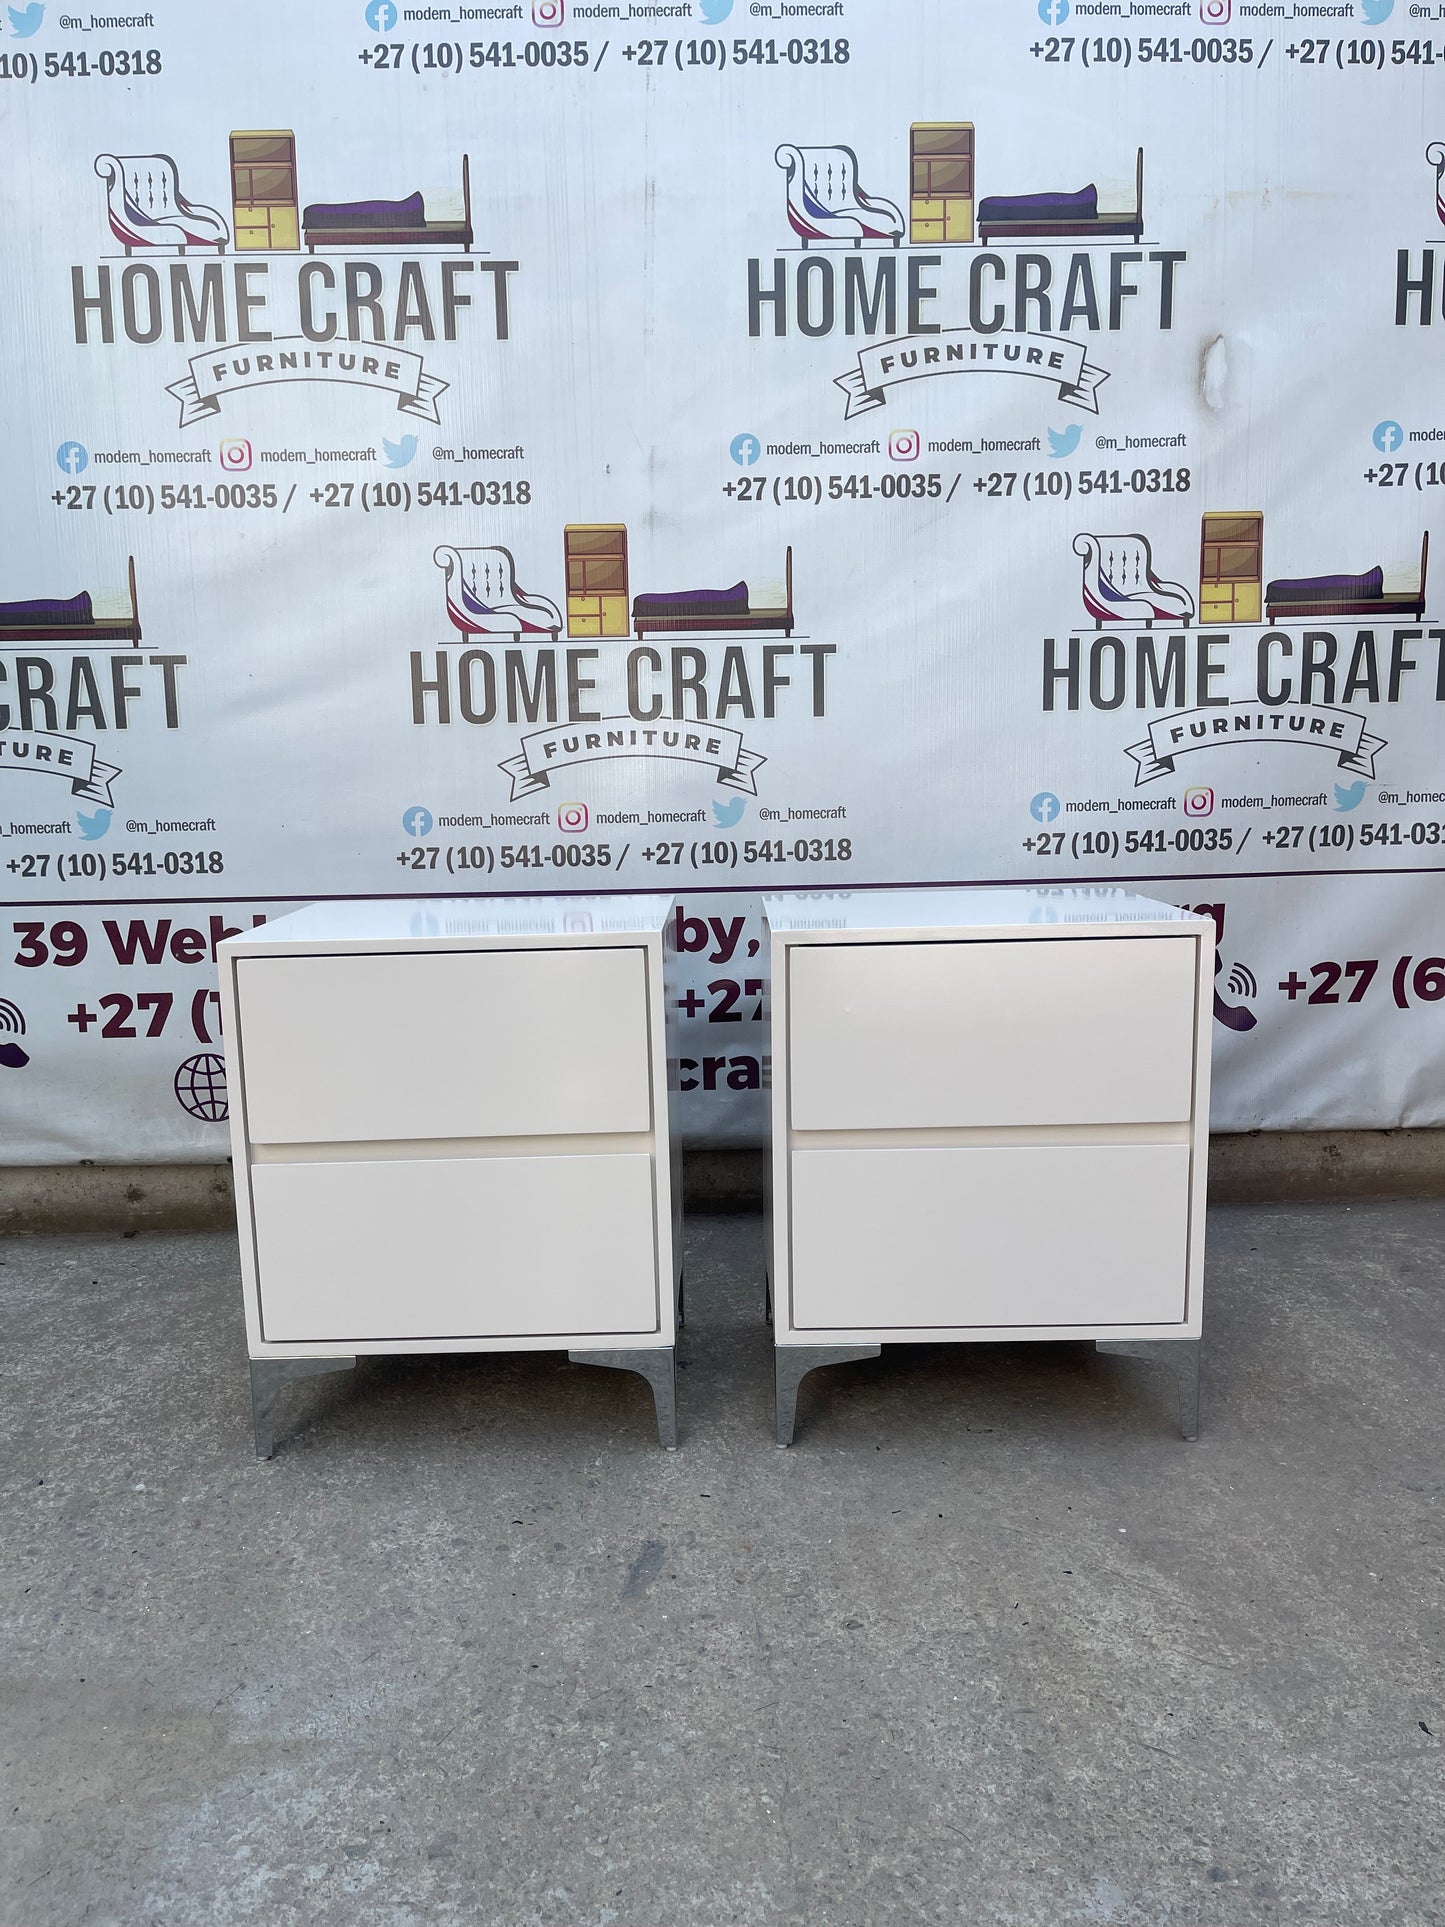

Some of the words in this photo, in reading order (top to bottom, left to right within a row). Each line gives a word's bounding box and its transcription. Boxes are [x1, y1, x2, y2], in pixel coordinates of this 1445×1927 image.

[60, 13, 154, 31] @m_homecraft
[750, 2, 844, 19] @m_homecraft
[45, 50, 161, 77] 541-0318
[359, 44, 404, 69] +27
[412, 43, 462, 74] (10)
[470, 41, 588, 67] 541-0035
[622, 40, 668, 65] +27
[675, 40, 726, 71] (10)
[733, 39, 849, 64] 541-0318
[1030, 37, 1075, 62] +27
[1082, 38, 1131, 68] (10)
[1138, 38, 1253, 63] 541-0035
[1286, 39, 1330, 63] +27
[1336, 40, 1385, 69] (10)
[1391, 40, 1445, 64] 541-
[71, 263, 270, 344] HOME
[298, 260, 519, 343] CRAFT
[747, 255, 942, 337] HOME
[968, 251, 1187, 333] CRAFT
[1395, 249, 1445, 326] H
[213, 351, 402, 382] FURNITURE
[881, 343, 1066, 375] FURNITURE
[1096, 433, 1186, 451] @m_homecraft
[1410, 428, 1445, 441] mode
[433, 446, 524, 462] @m_homecraft
[723, 477, 766, 501] +27
[773, 476, 822, 505] (10)
[828, 474, 941, 499] 541-0035
[973, 473, 1017, 496] +27
[1023, 472, 1072, 501] (10)
[1078, 468, 1190, 494] 541-0318
[1364, 463, 1408, 486] +27
[52, 486, 96, 509] +27
[104, 485, 154, 515] (10)
[161, 484, 277, 509] 541-0035
[310, 483, 354, 507] +27
[362, 482, 411, 512] (10)
[418, 481, 531, 506] 541-0318
[409, 648, 600, 725] HOME
[627, 643, 837, 722] CRAFT
[1042, 634, 1230, 711] HOME
[542, 729, 721, 759] FURNITURE
[1170, 714, 1346, 744] FURNITURE
[0, 821, 72, 837] _homecraft
[126, 818, 216, 834] @m_homecraft
[759, 806, 846, 822] @m_homecraft
[397, 847, 440, 869] +27
[447, 846, 494, 874] (10)
[501, 844, 611, 868] 541-0035
[642, 843, 684, 865] +27
[691, 841, 737, 869] (10)
[744, 838, 851, 863] 541-0318
[1023, 833, 1065, 855] +27
[1072, 831, 1119, 859] (10)
[1125, 828, 1232, 853] 541-0035
[1263, 826, 1304, 848] +27
[1309, 825, 1354, 852] (10)
[6, 855, 50, 877] +27
[57, 854, 106, 881] (10)
[112, 851, 223, 875] 541-0318
[13, 921, 88, 967] 39
[1279, 960, 1378, 1004] +27
[68, 993, 173, 1038] +27
